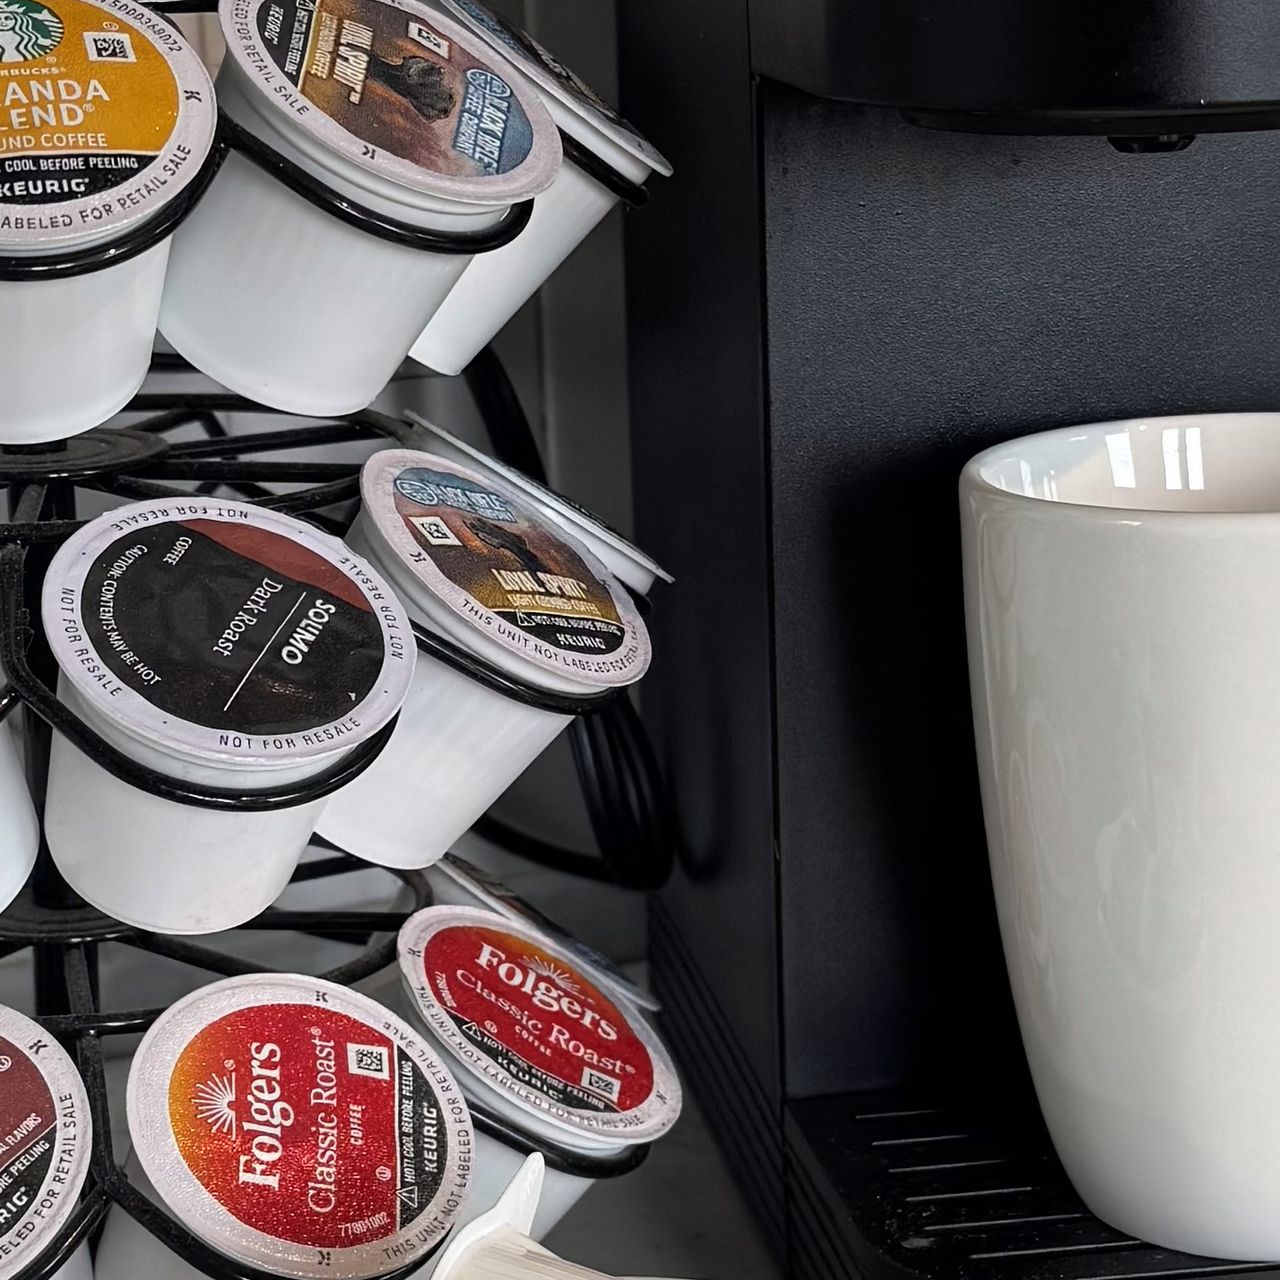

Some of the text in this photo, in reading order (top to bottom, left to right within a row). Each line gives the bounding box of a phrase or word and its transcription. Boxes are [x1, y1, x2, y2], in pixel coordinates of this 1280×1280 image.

[235, 21, 252, 42] FOR
[273, 84, 311, 116] SALE
[4, 159, 38, 172] COOL
[40, 157, 87, 170] BEFORE
[88, 155, 139, 170] PEELING
[41, 132, 108, 148] COFFEE
[79, 201, 114, 223] FOR
[115, 177, 169, 212] RETAIL
[162, 143, 193, 178] SALE
[162, 536, 193, 567] COFFEE
[98, 579, 118, 631] CONTENTS
[212, 576, 284, 658] Dark Roast
[461, 598, 495, 627] THIS
[497, 623, 532, 649] UNIT
[106, 630, 130, 653] MAY
[280, 597, 337, 666] SOLIMO
[73, 646, 124, 698] RESALE
[120, 650, 140, 666] BE
[133, 662, 162, 686] HOT
[219, 715, 363, 751] NOT FOR RESALE
[456, 969, 544, 1035] Classic
[474, 940, 619, 1042] Folgers
[6, 1112, 43, 1150] FLAVORS
[59, 1090, 78, 1130] SALE
[238, 1041, 296, 1193] Folgers
[349, 1103, 367, 1147] COFFEE
[402, 1095, 416, 1137] BEFORE
[9, 1137, 51, 1179] PEELING
[55, 1133, 78, 1189] RETAIL
[308, 1112, 339, 1214] Classic
[382, 1051, 473, 1261] THIS NOT LABELED FOR RETAIL
[423, 1101, 440, 1174] KEURIG
[34, 1189, 61, 1220] FOR
